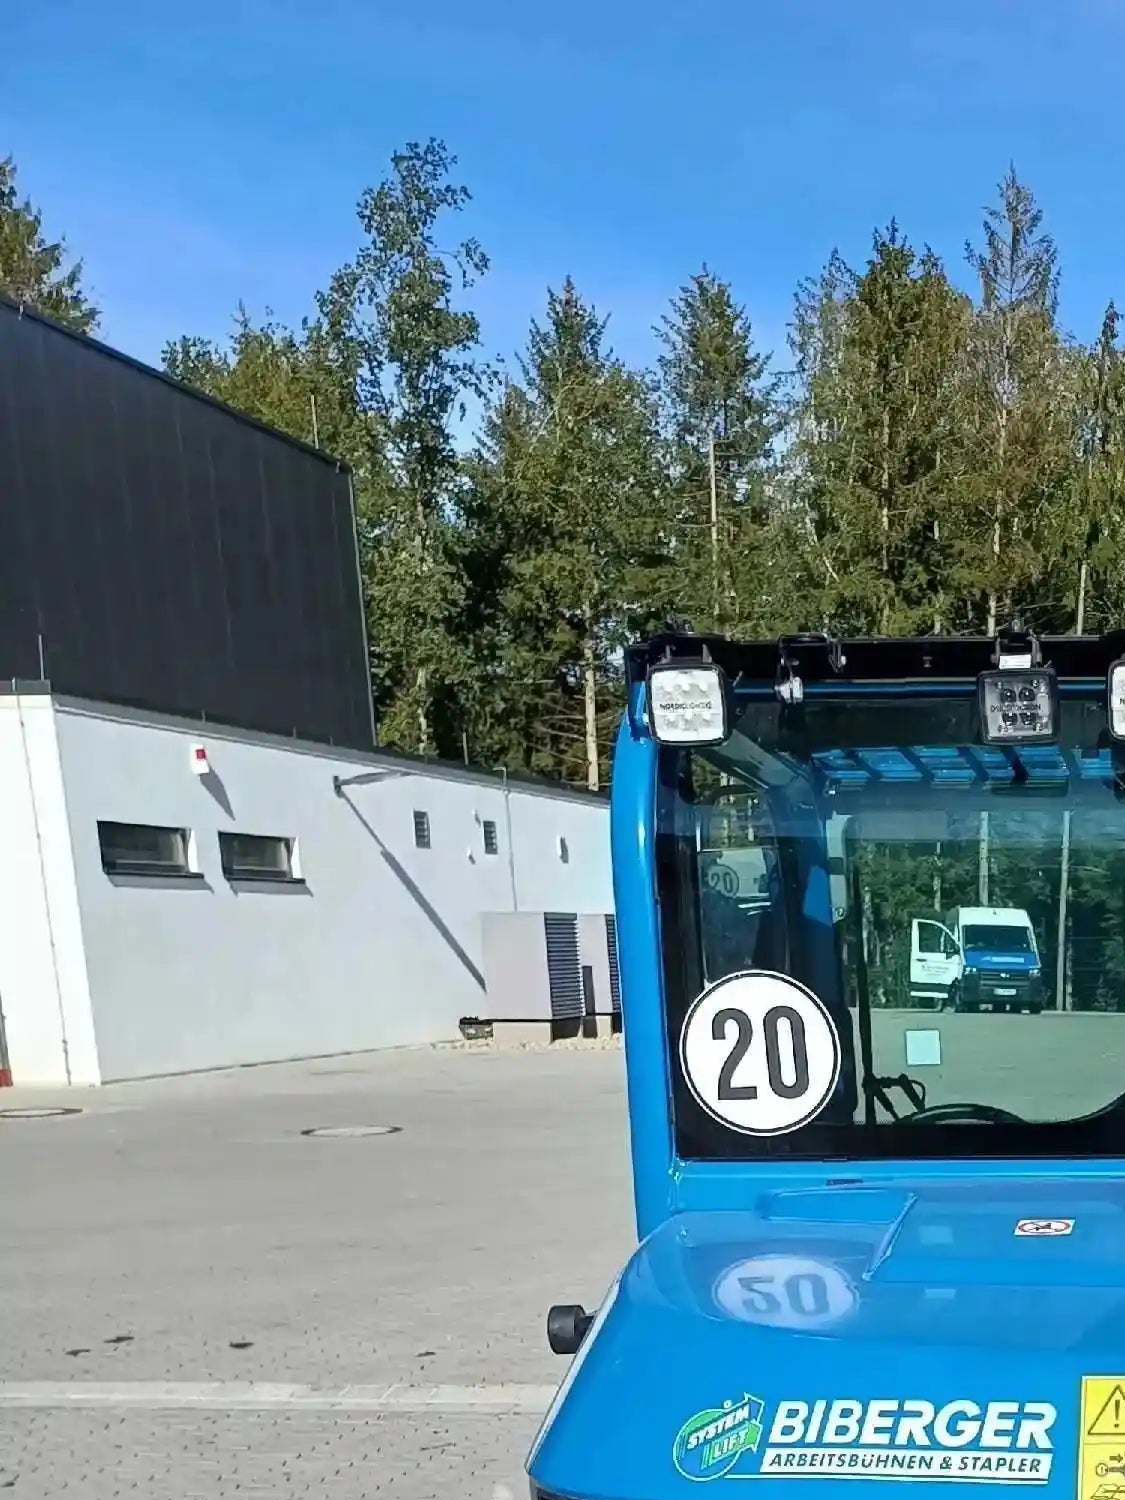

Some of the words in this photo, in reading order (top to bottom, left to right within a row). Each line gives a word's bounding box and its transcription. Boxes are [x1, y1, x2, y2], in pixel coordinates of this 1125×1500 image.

[712, 1005, 810, 1101] 20
[687, 1403, 749, 1449] SYSTEM
[714, 1428, 749, 1458] LIFT
[767, 1399, 1057, 1449] BIBERGER
[769, 1452, 933, 1470] ARBEITSBÜHNEN
[939, 1455, 953, 1470] &
[958, 1456, 1042, 1473] STAPLER
